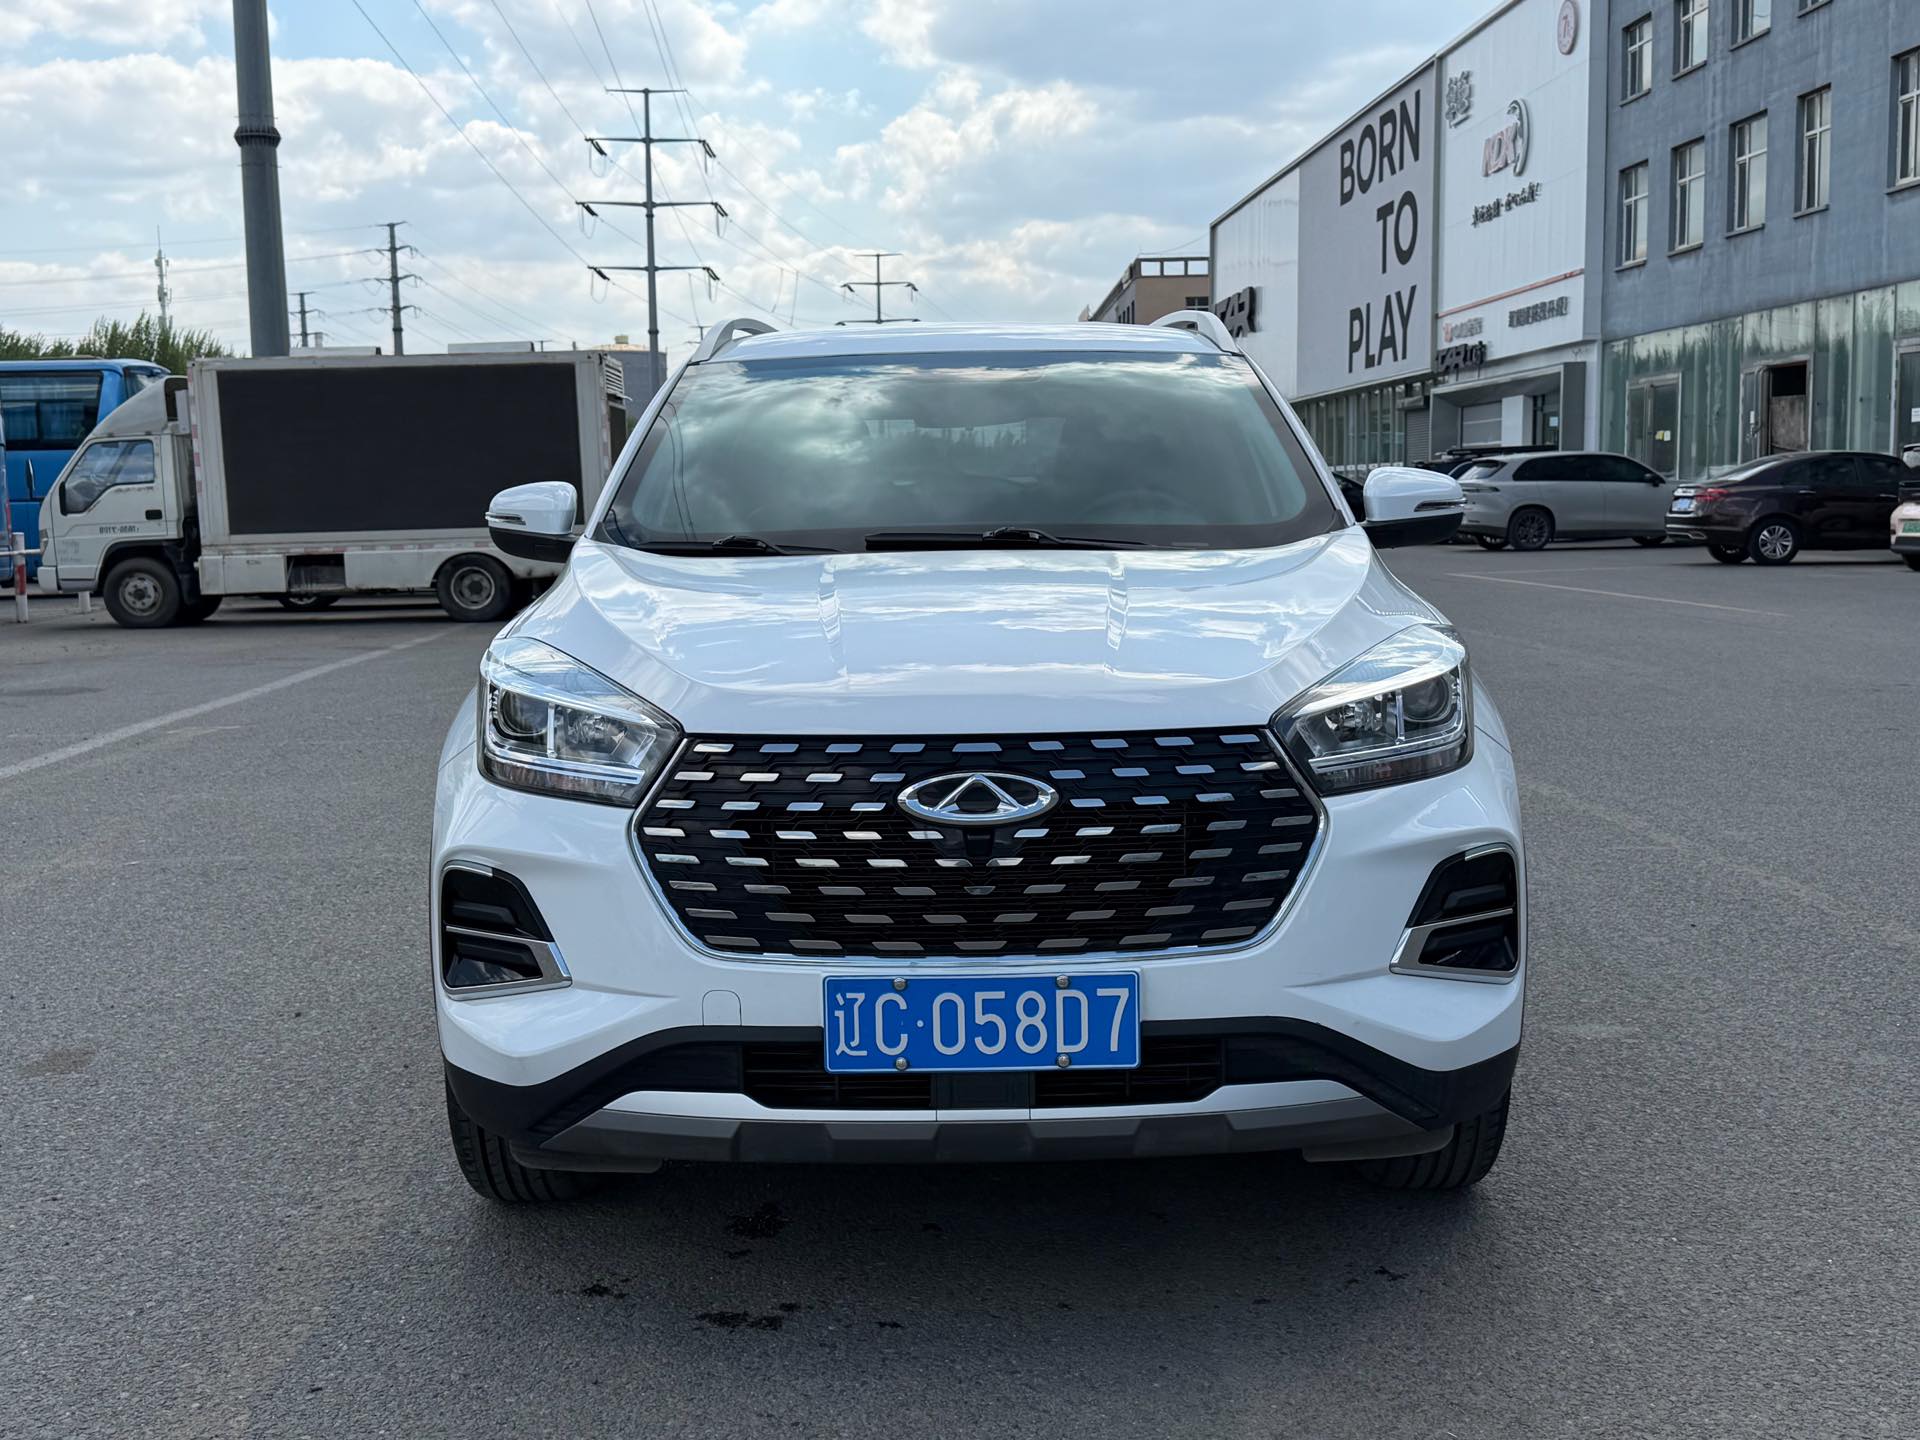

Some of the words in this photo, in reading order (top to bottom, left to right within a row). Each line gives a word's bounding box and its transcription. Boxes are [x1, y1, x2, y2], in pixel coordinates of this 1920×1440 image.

[1340, 89, 1420, 206] BORN
[1376, 190, 1418, 274] TO
[1348, 285, 1417, 373] PLAY
